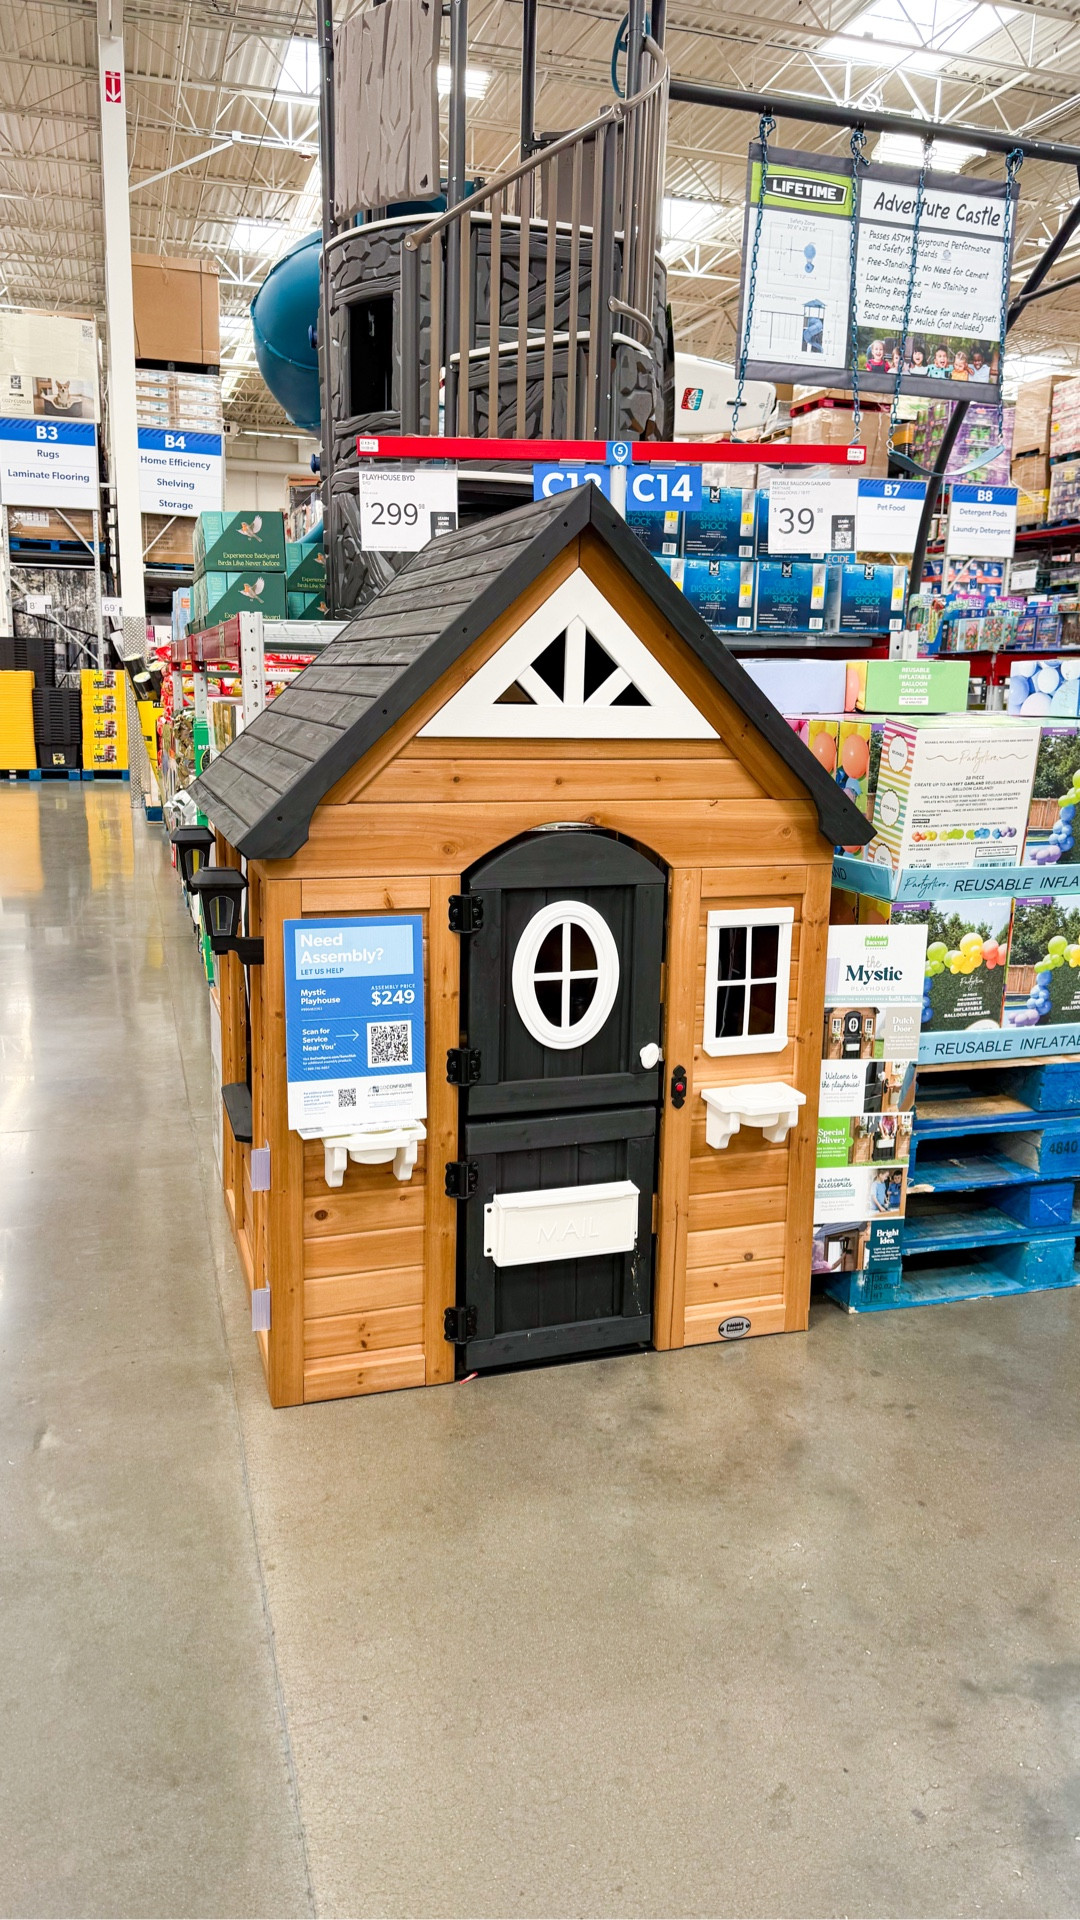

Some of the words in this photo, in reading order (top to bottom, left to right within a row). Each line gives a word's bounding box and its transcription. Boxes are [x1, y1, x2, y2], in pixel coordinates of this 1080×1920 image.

[772, 179, 837, 200] LIFETIME
[956, 203, 1001, 227] Castle
[868, 229, 891, 241] Passes
[891, 232, 911, 242] ASTM
[951, 240, 991, 255] Performance
[868, 243, 881, 252] and
[883, 244, 905, 256] Safety
[922, 264, 932, 272] No
[934, 265, 951, 275] Need
[953, 267, 963, 276] for
[965, 269, 990, 280] Cement
[865, 272, 880, 281] Low
[931, 281, 942, 289] No
[942, 282, 969, 295] Staining
[864, 284, 891, 298] Painting
[913, 304, 938, 317] Surface
[939, 308, 950, 318] for
[951, 310, 971, 320] under
[862, 310, 881, 321] Sand
[915, 316, 936, 328] Mulch
[936, 318, 952, 329] (not
[952, 320, 985, 334] included)
[35, 425, 59, 441] B3
[164, 434, 187, 450] B4
[36, 449, 60, 460] Rugs
[617, 446, 624, 455] 5
[140, 455, 167, 466] Home
[168, 457, 211, 471] Efficiency
[7, 468, 50, 480] Laminate
[52, 471, 90, 483] Flooring
[361, 473, 401, 482] PLAYHOUSE
[401, 473, 416, 482] BYD
[156, 478, 195, 490] Shelving
[632, 473, 694, 503] C14
[883, 483, 901, 497] B7
[977, 489, 994, 502] B8
[158, 499, 194, 511] Storage
[876, 503, 888, 511] Pet
[888, 503, 906, 512] Food
[959, 508, 991, 518] Detergent
[992, 509, 1008, 518] Pods
[700, 521, 728, 530] SHOCK
[952, 525, 979, 535] Laundry
[979, 526, 1011, 536] Detergent
[223, 552, 254, 561] Experience
[217, 559, 233, 567] Birds
[232, 559, 245, 567] Like
[262, 559, 280, 567] Before
[699, 593, 727, 602] SHOCK
[772, 595, 799, 604] SHOCK
[855, 596, 880, 605] SHOCK
[953, 877, 1034, 893] REUSABLE
[300, 932, 344, 948] Need
[300, 947, 385, 965] Assembly?
[866, 955, 882, 969] the
[300, 968, 313, 976] LET
[844, 964, 904, 986] Mystic
[300, 987, 327, 998] Mystic
[370, 983, 399, 991] ASSEMBLY
[300, 996, 341, 1007] Playhouse
[371, 989, 416, 1008] $249
[892, 1016, 915, 1025] Dutch
[302, 1028, 319, 1036] Scan
[319, 1027, 331, 1035] for
[893, 1025, 913, 1033] Door
[302, 1036, 329, 1045] Service
[302, 1044, 320, 1052] Near
[934, 1039, 1014, 1057] REUSABLE
[824, 1071, 851, 1081] Welcome
[851, 1072, 858, 1080] to
[821, 1080, 830, 1089] the
[818, 1128, 846, 1138] Special
[1049, 1140, 1079, 1155] 4840
[536, 1214, 601, 1245] MAIL
[876, 1228, 900, 1239] Bright
[879, 1236, 895, 1245] Idea
